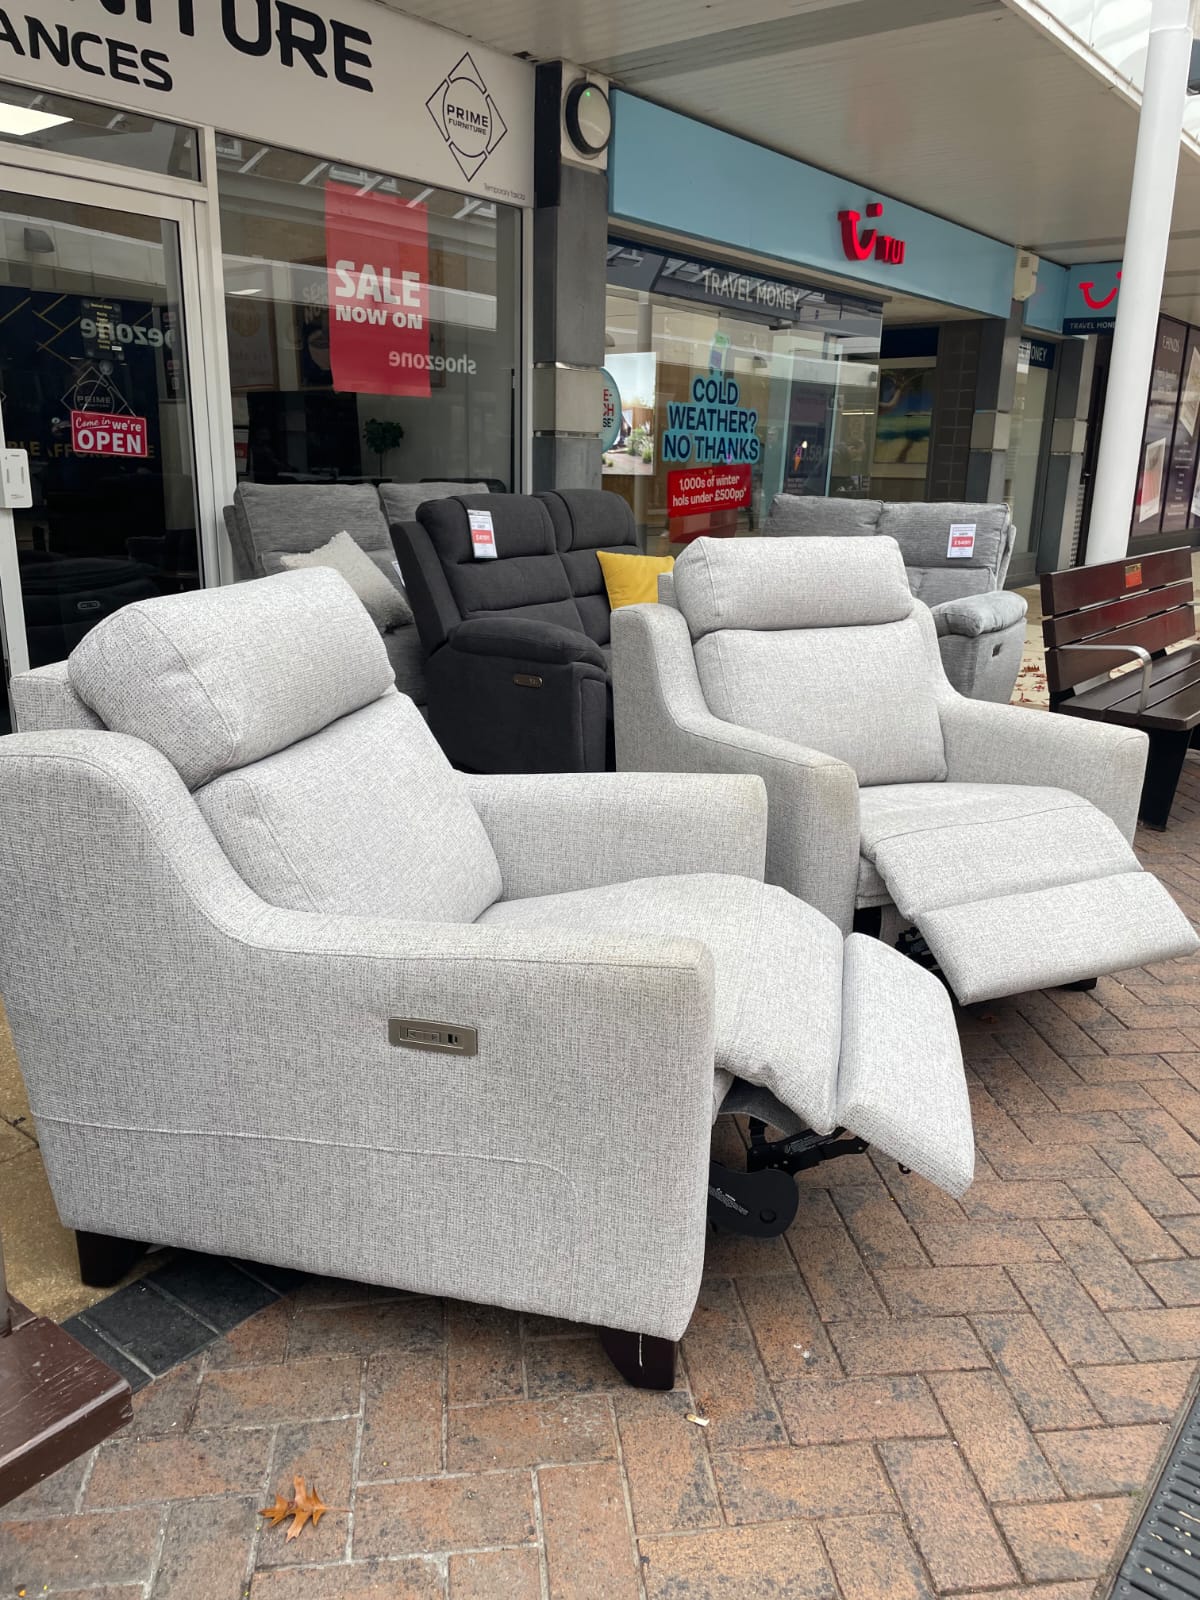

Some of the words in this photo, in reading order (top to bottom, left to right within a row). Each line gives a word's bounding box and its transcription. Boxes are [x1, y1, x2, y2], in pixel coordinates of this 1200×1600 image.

[0, 8, 173, 93] ANCES
[446, 104, 488, 128] PRIME
[448, 118, 488, 136] FURNITURE
[876, 234, 906, 265] TUI
[335, 260, 421, 308] SALE
[702, 268, 753, 303] TRAVEL
[756, 285, 800, 311] MONEY
[336, 304, 387, 326] NOW
[392, 312, 423, 330] ON
[1070, 321, 1095, 329] TRAVEL
[1029, 344, 1048, 362] ONEY
[693, 378, 739, 406] COLD
[75, 417, 100, 429] Come
[101, 418, 112, 426] in
[112, 420, 142, 432] we're
[669, 405, 757, 434] WEATHER?
[78, 429, 142, 454] OPEN
[664, 434, 691, 459] NO
[694, 435, 759, 460] THANKS
[707, 475, 715, 487] of
[716, 474, 740, 487] winter
[672, 494, 689, 507] hols
[690, 491, 713, 504] under
